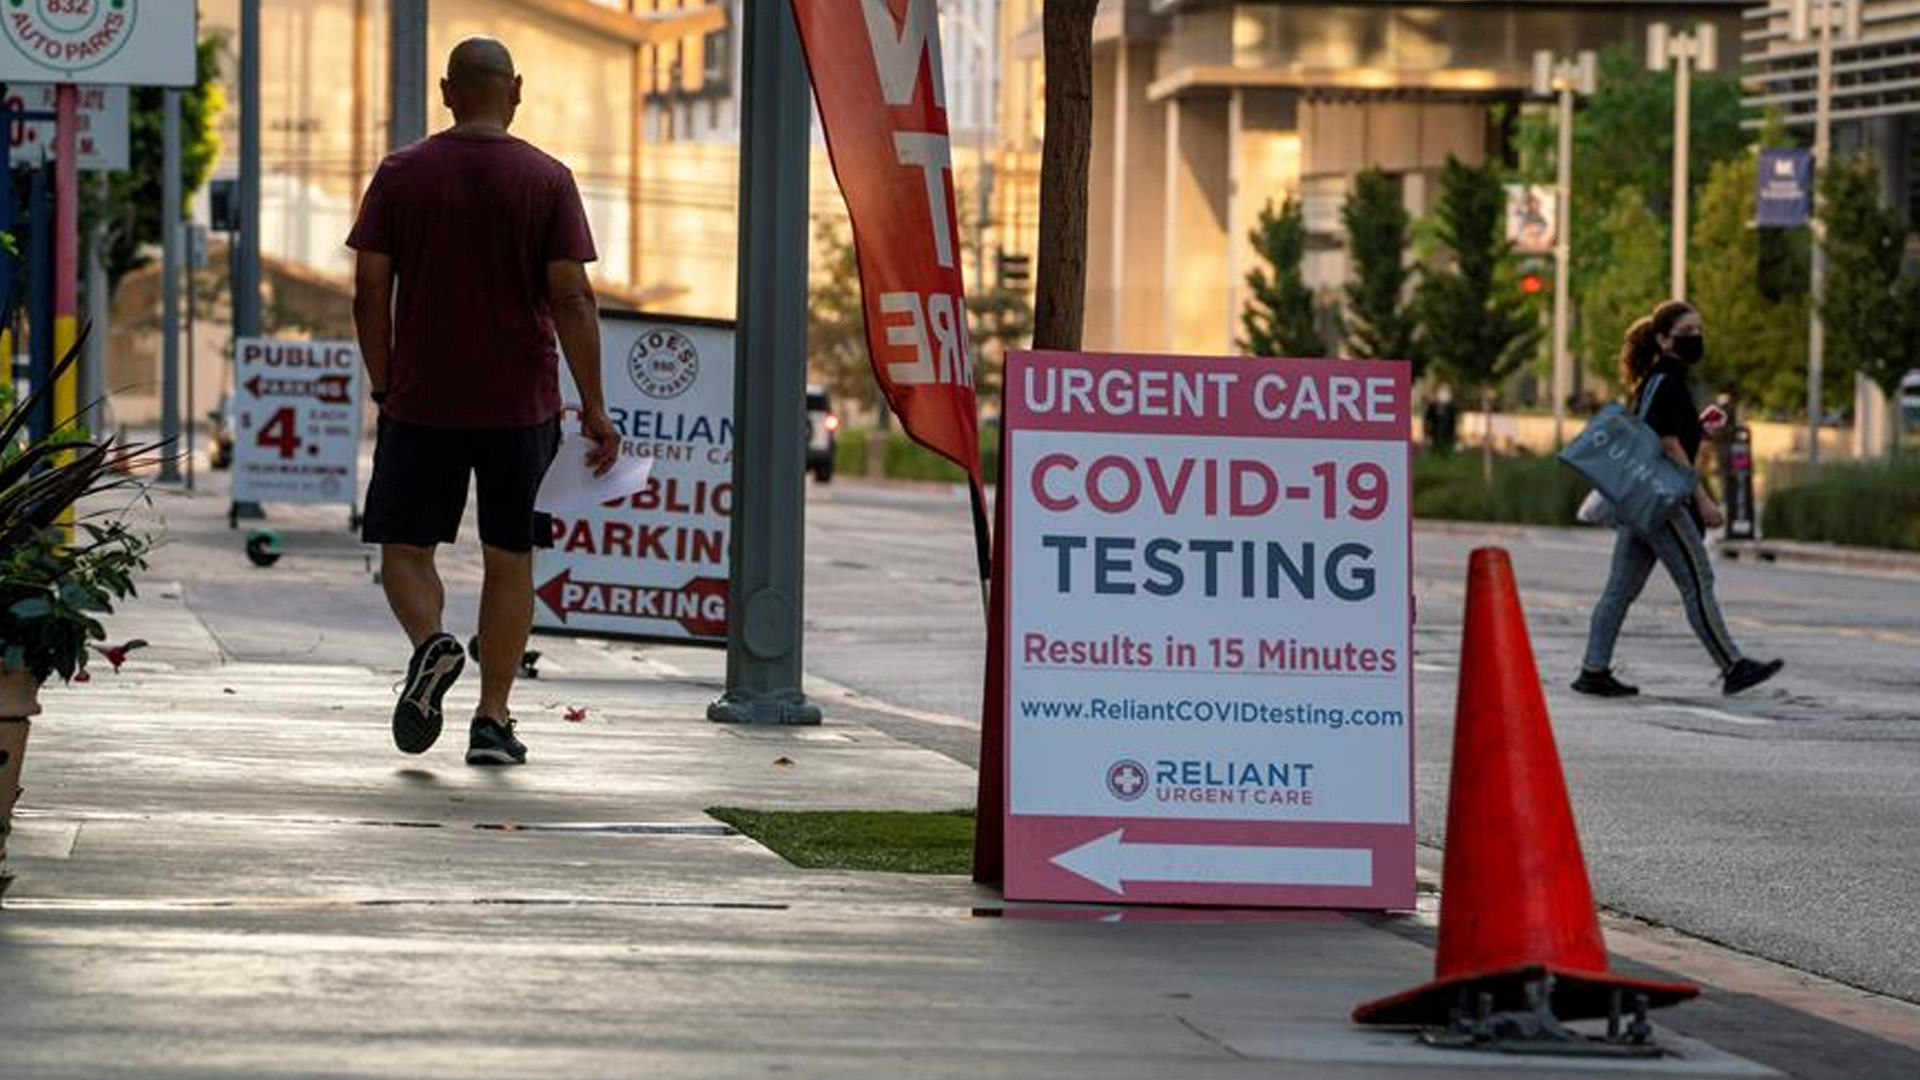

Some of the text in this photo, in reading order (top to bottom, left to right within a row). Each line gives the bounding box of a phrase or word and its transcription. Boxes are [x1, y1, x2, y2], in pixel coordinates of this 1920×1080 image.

[11, 12, 125, 61] AUTO PARKS
[244, 345, 351, 369] PUBLIC
[1023, 366, 1397, 422] URGENT CARE
[609, 407, 734, 445] RELIAN
[622, 440, 694, 462] RGENT
[602, 476, 733, 517] BLIC
[1030, 452, 1390, 521] COVID-19
[551, 517, 723, 564] PARKIN
[1042, 534, 1376, 601] TESTING
[561, 582, 725, 622] PARKING
[1023, 632, 1397, 672] Results in 15 Minutes
[1021, 698, 1404, 729] www.ReliantCOVIDtesting.com
[1156, 761, 1314, 788] RELIANT
[1156, 788, 1313, 806] URGENT CARE
